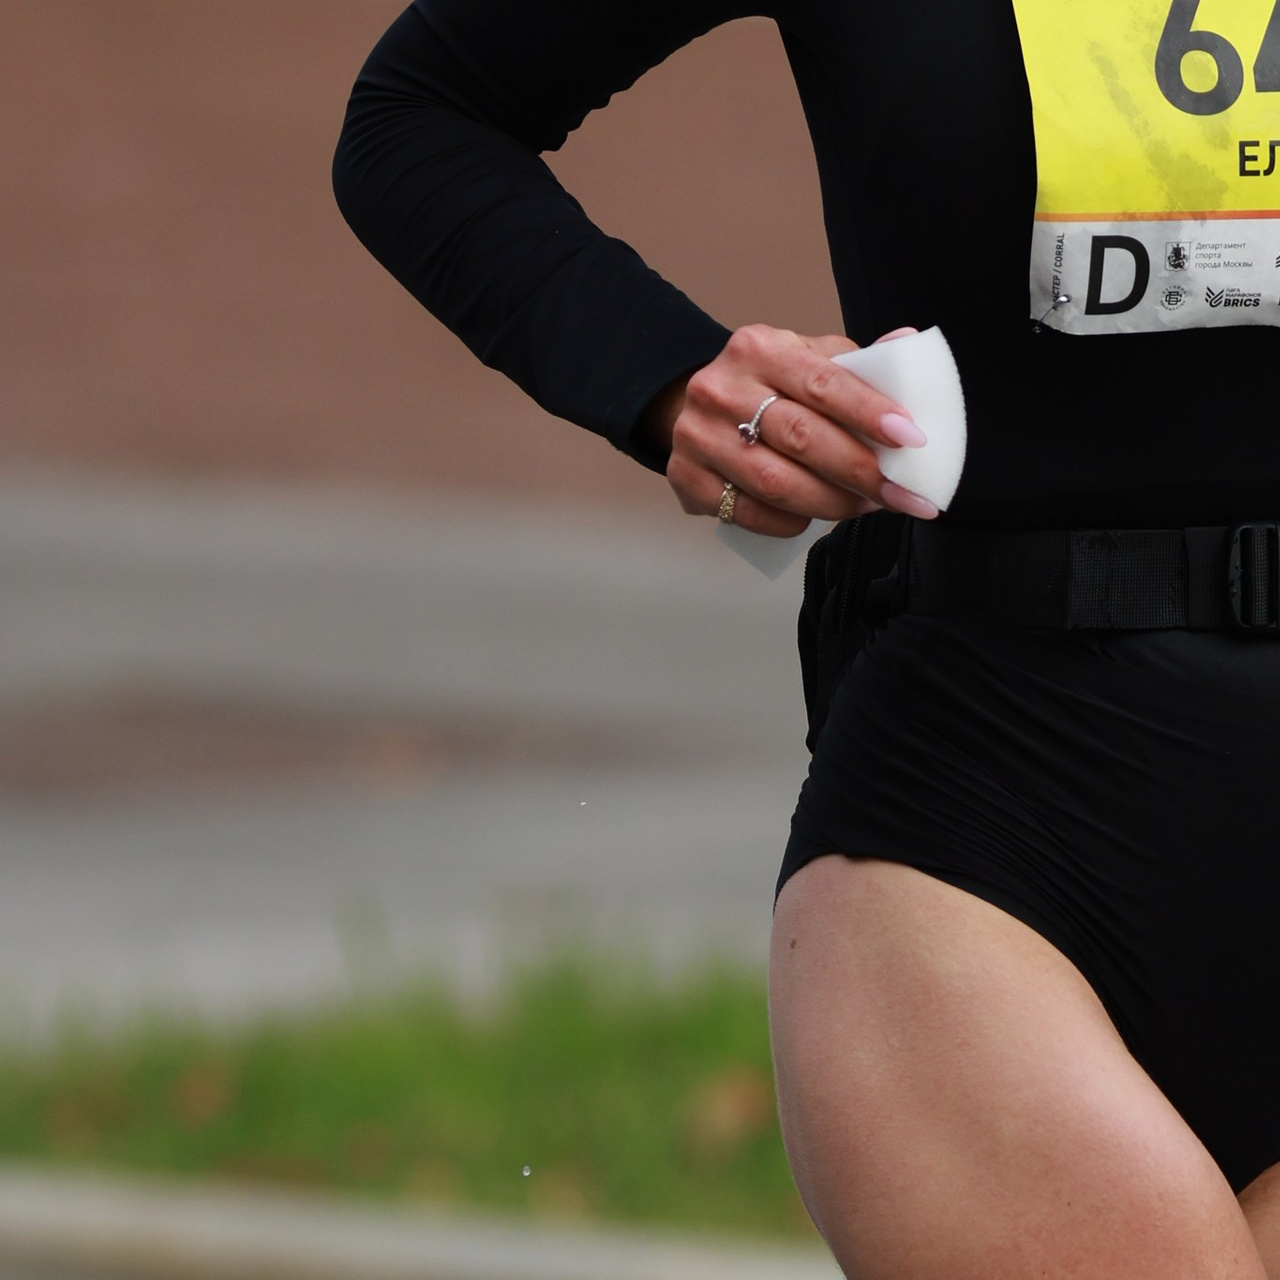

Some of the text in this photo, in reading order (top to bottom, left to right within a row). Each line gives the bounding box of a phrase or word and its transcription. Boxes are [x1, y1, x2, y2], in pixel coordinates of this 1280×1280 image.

[1054, 233, 1065, 268] CORRAL
[1195, 242, 1246, 251] Департамент
[1084, 235, 1150, 315] D
[1223, 298, 1260, 307] BRICS
